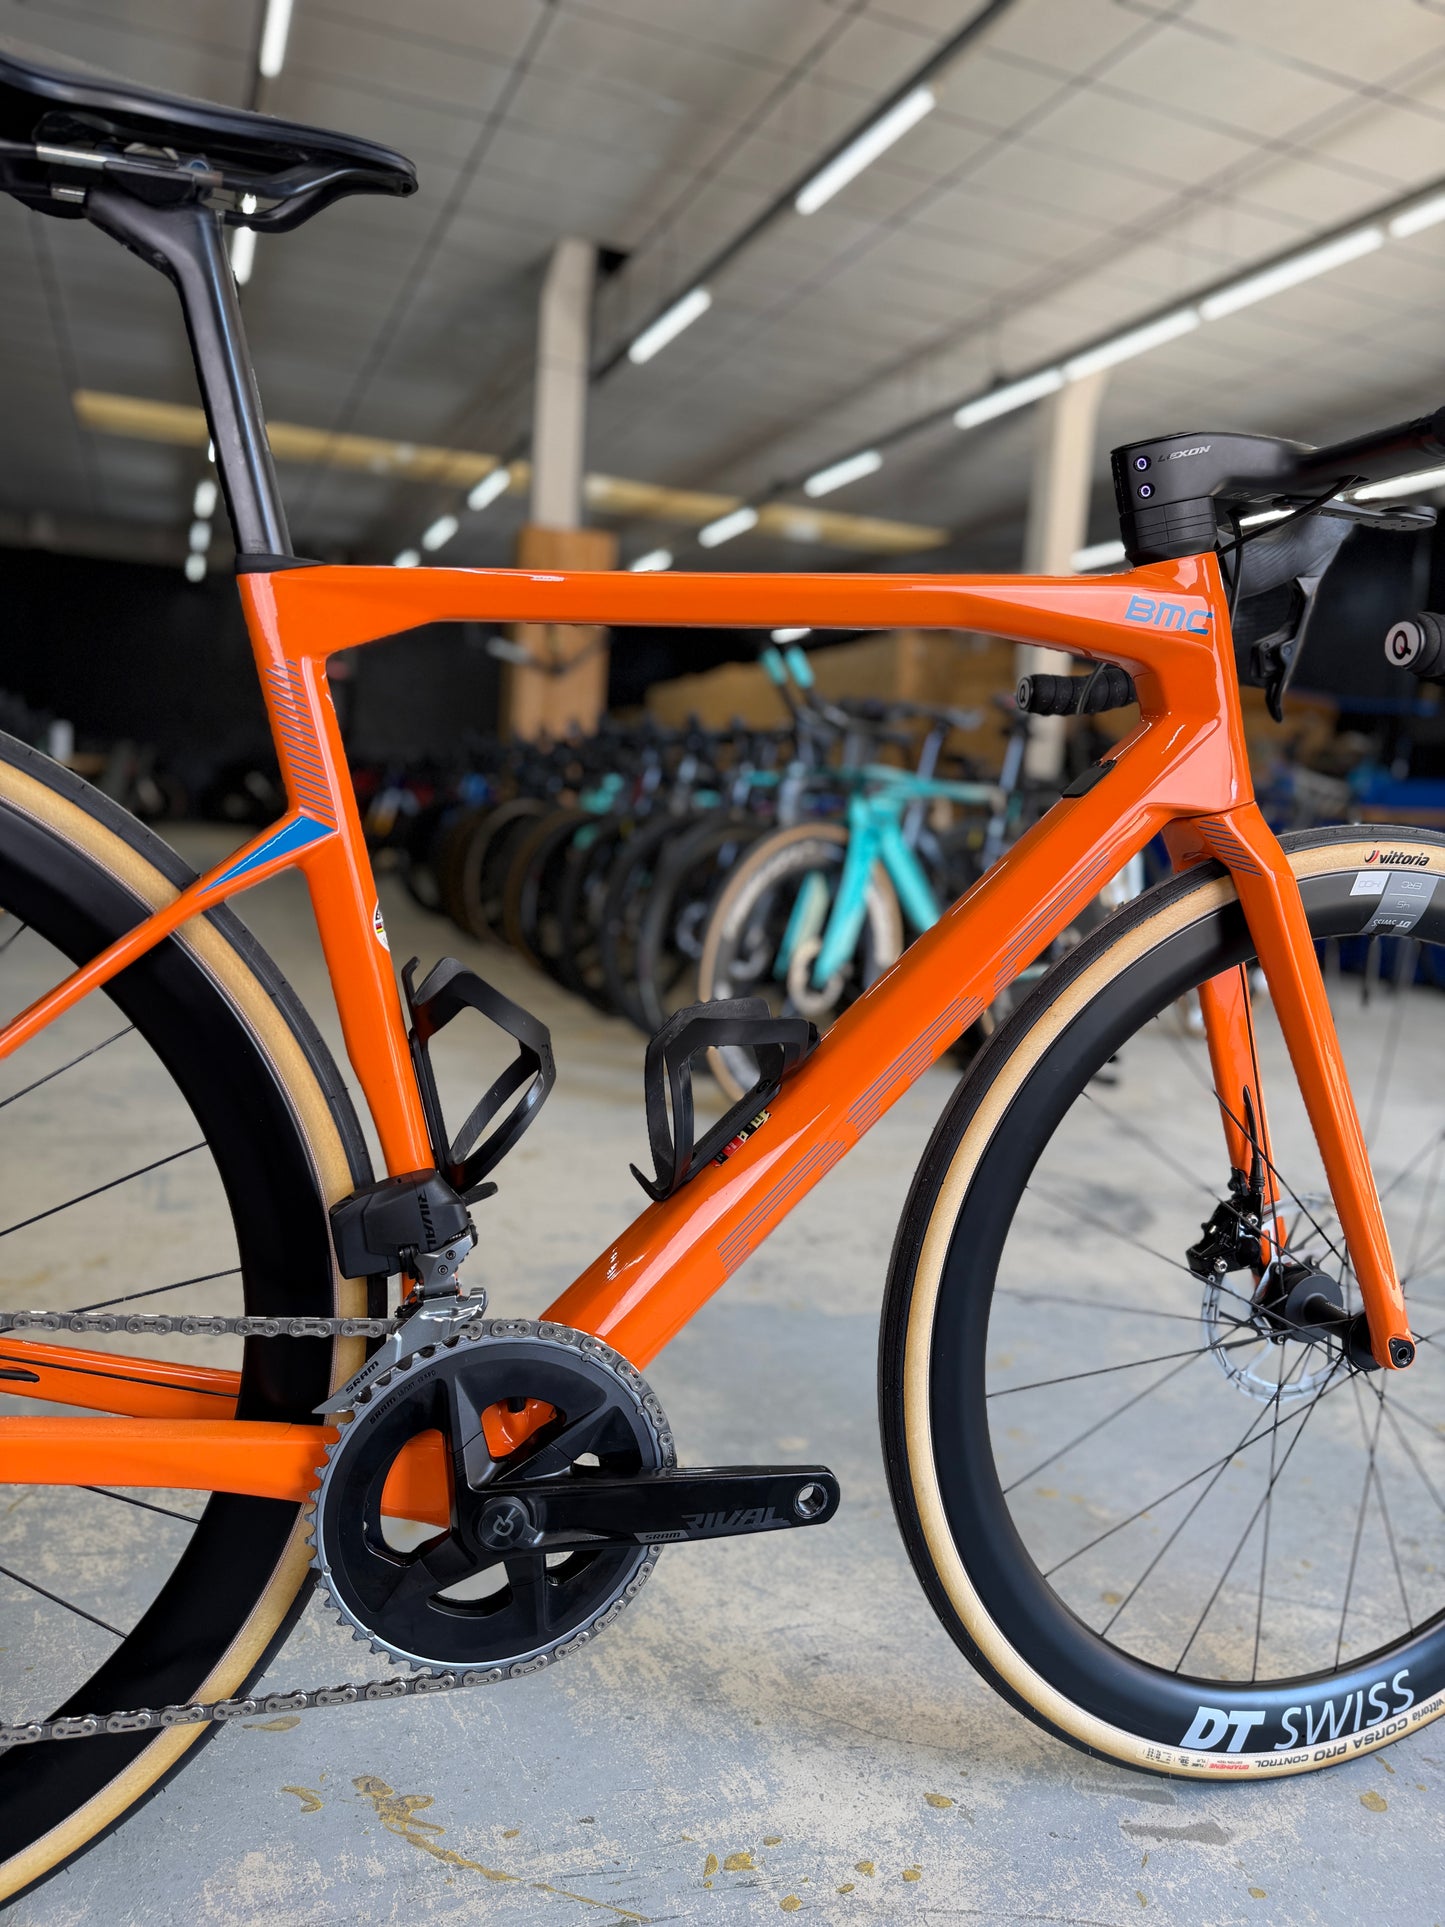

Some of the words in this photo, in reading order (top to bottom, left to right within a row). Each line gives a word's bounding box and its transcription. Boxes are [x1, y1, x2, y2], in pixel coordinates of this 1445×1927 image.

[1158, 445, 1211, 463] LEXON
[1125, 594, 1213, 636] BMC
[1379, 850, 1430, 867] vittoria
[1396, 920, 1412, 929] DT
[415, 1187, 437, 1250] RIVAL
[345, 1360, 379, 1394] SRAM
[644, 1531, 681, 1541] SRAM
[680, 1506, 792, 1532] RIVAL
[1178, 1705, 1266, 1753] DT
[1273, 1668, 1415, 1751] SWISS
[1411, 1697, 1445, 1722] vittoria
[1353, 1717, 1408, 1749] CORSA
[1254, 1754, 1309, 1768] CONTROL
[1313, 1742, 1348, 1762] PRO
